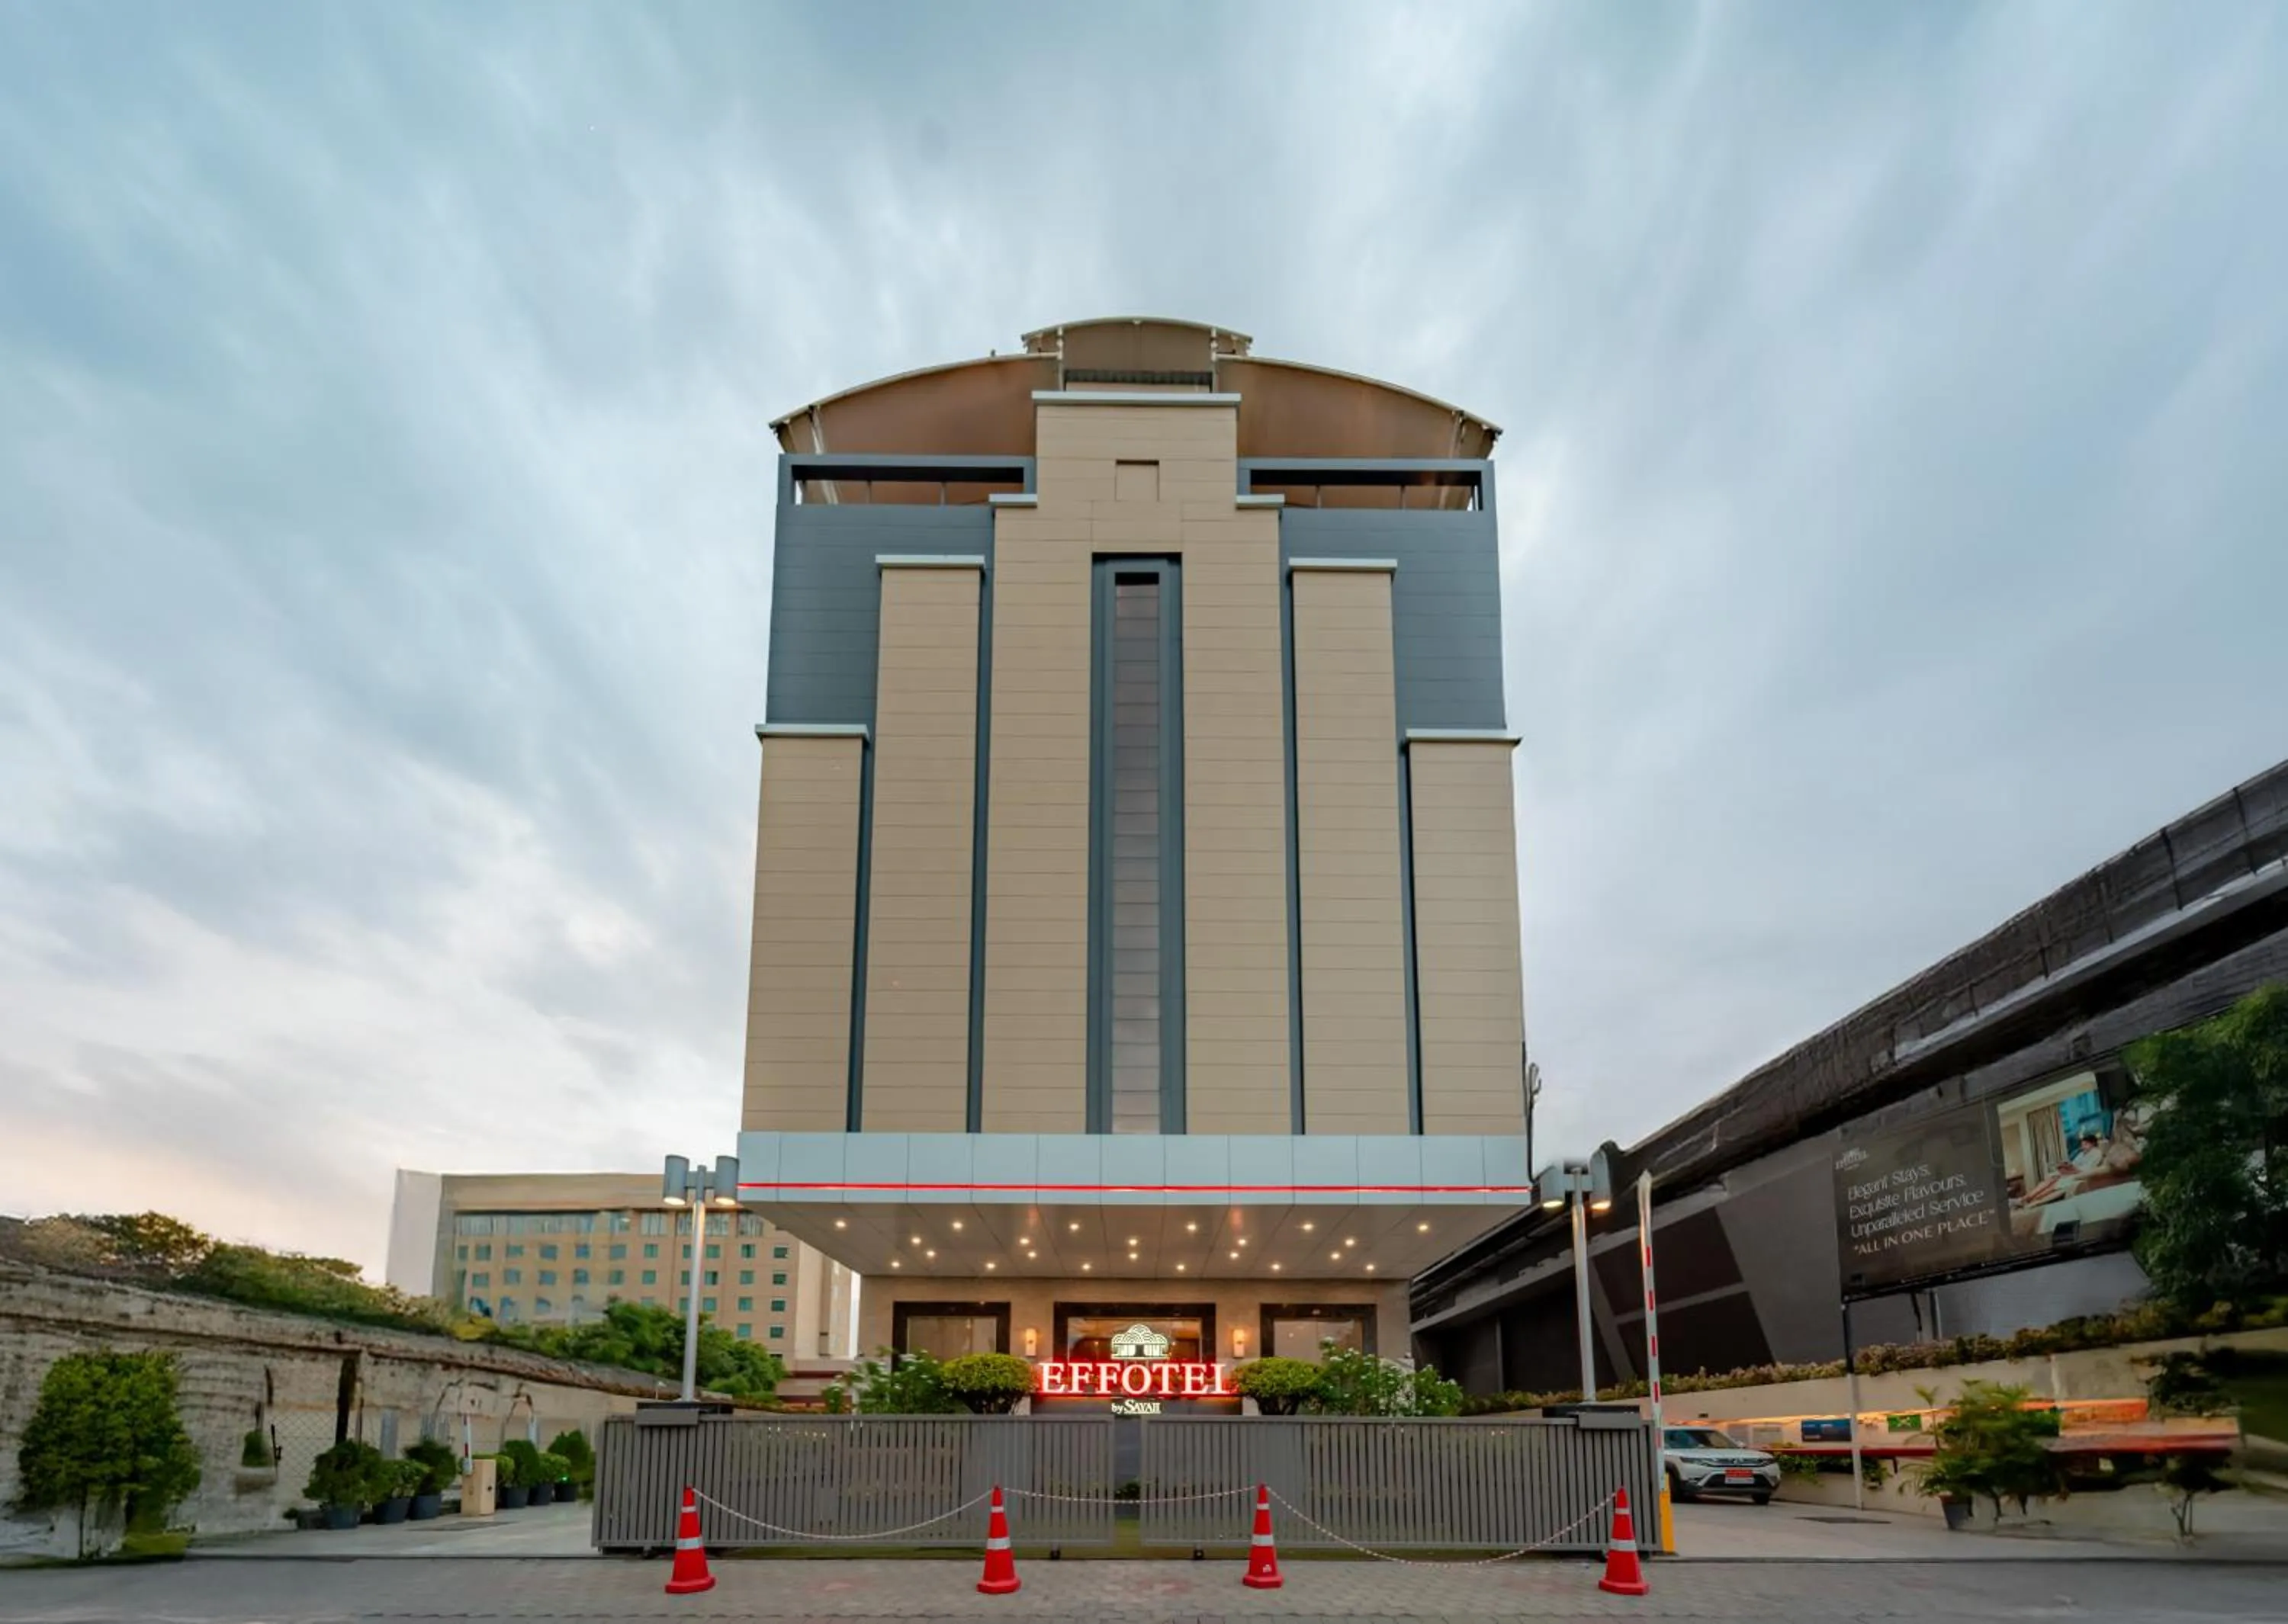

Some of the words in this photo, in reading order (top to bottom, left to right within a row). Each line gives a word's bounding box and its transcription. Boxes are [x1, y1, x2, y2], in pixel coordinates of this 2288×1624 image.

[1848, 1175, 1888, 1202] Elegant
[1849, 1194, 1900, 1220] Exquisite
[1851, 1203, 1924, 1238] Unparalleled
[1930, 1190, 1984, 1216] Service
[1884, 1234, 1899, 1249] IN
[1901, 1225, 1933, 1244] ONE
[1039, 1362, 1239, 1395] EFFOTEL
[1111, 1402, 1124, 1415] by
